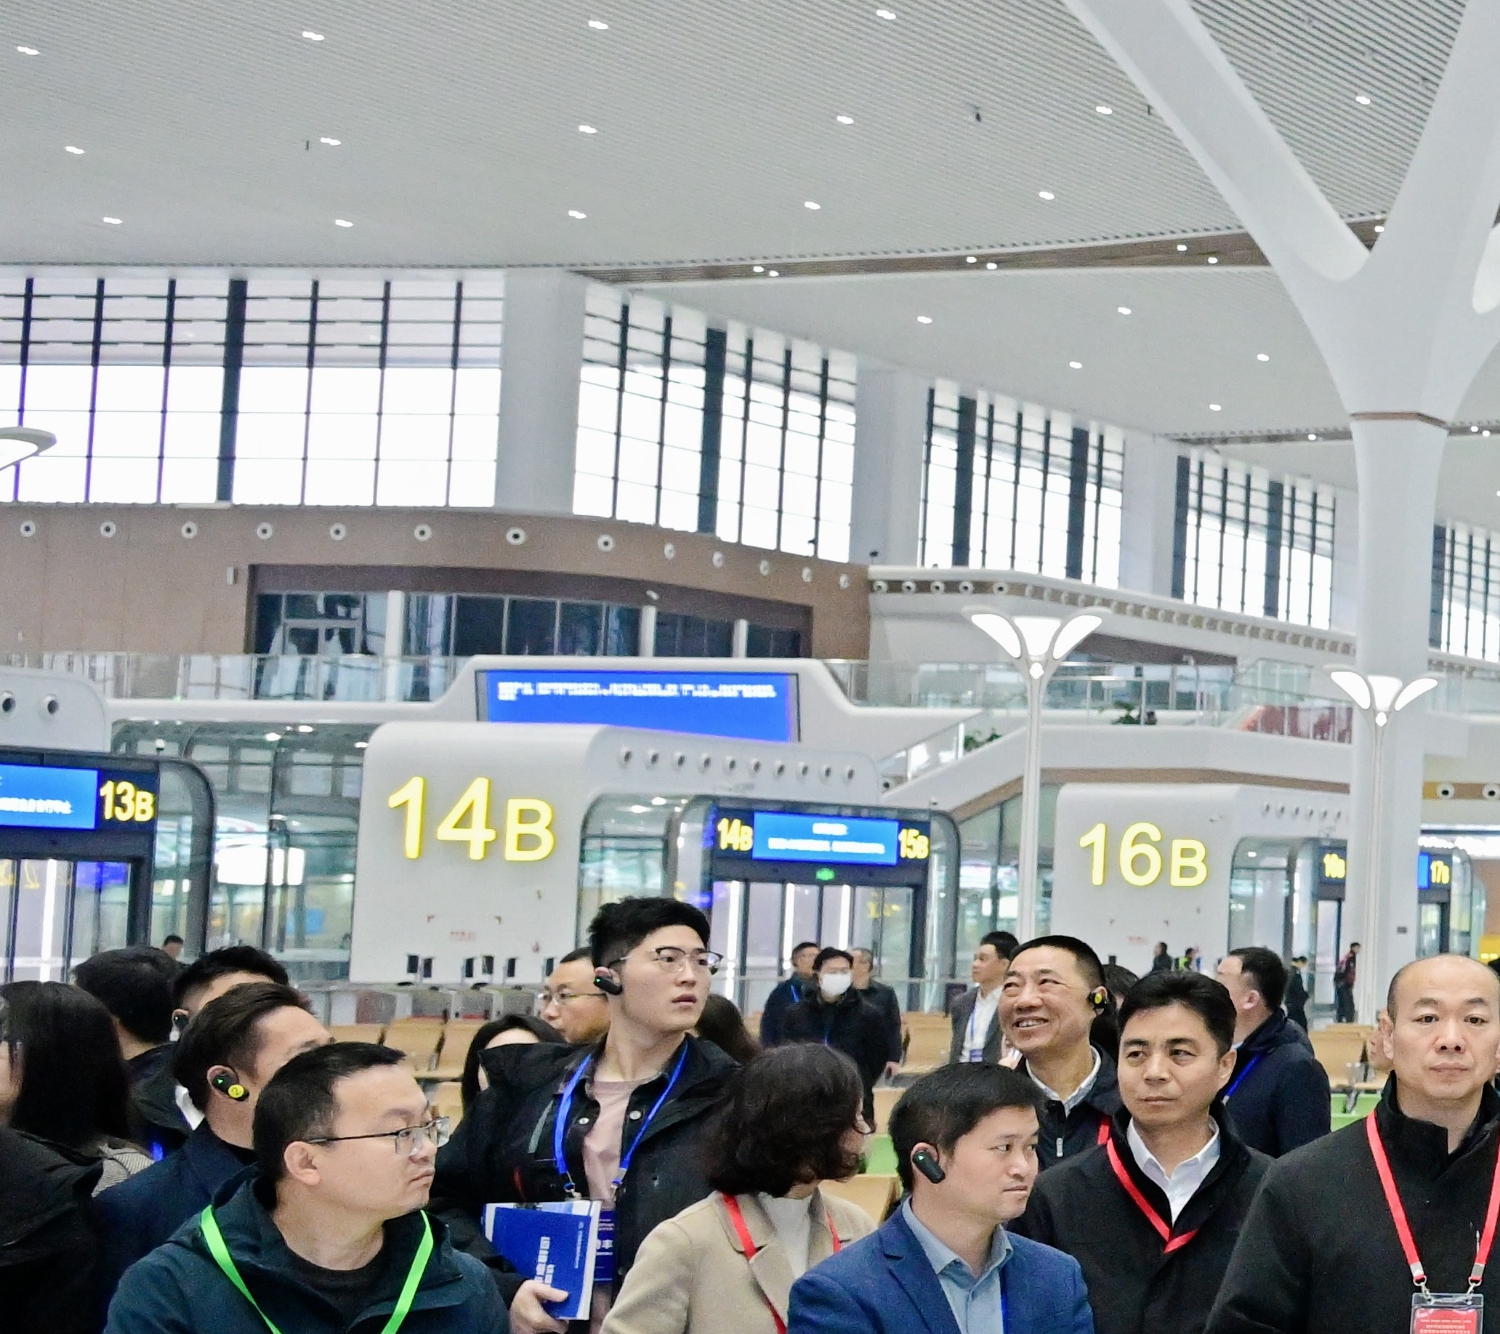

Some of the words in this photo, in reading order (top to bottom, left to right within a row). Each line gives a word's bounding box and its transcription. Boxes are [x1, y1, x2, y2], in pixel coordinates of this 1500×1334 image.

[100, 780, 155, 822] 13B
[387, 775, 557, 862] 14B
[718, 818, 753, 851] 14B
[899, 828, 930, 859] 15B
[1079, 822, 1209, 888] 16B
